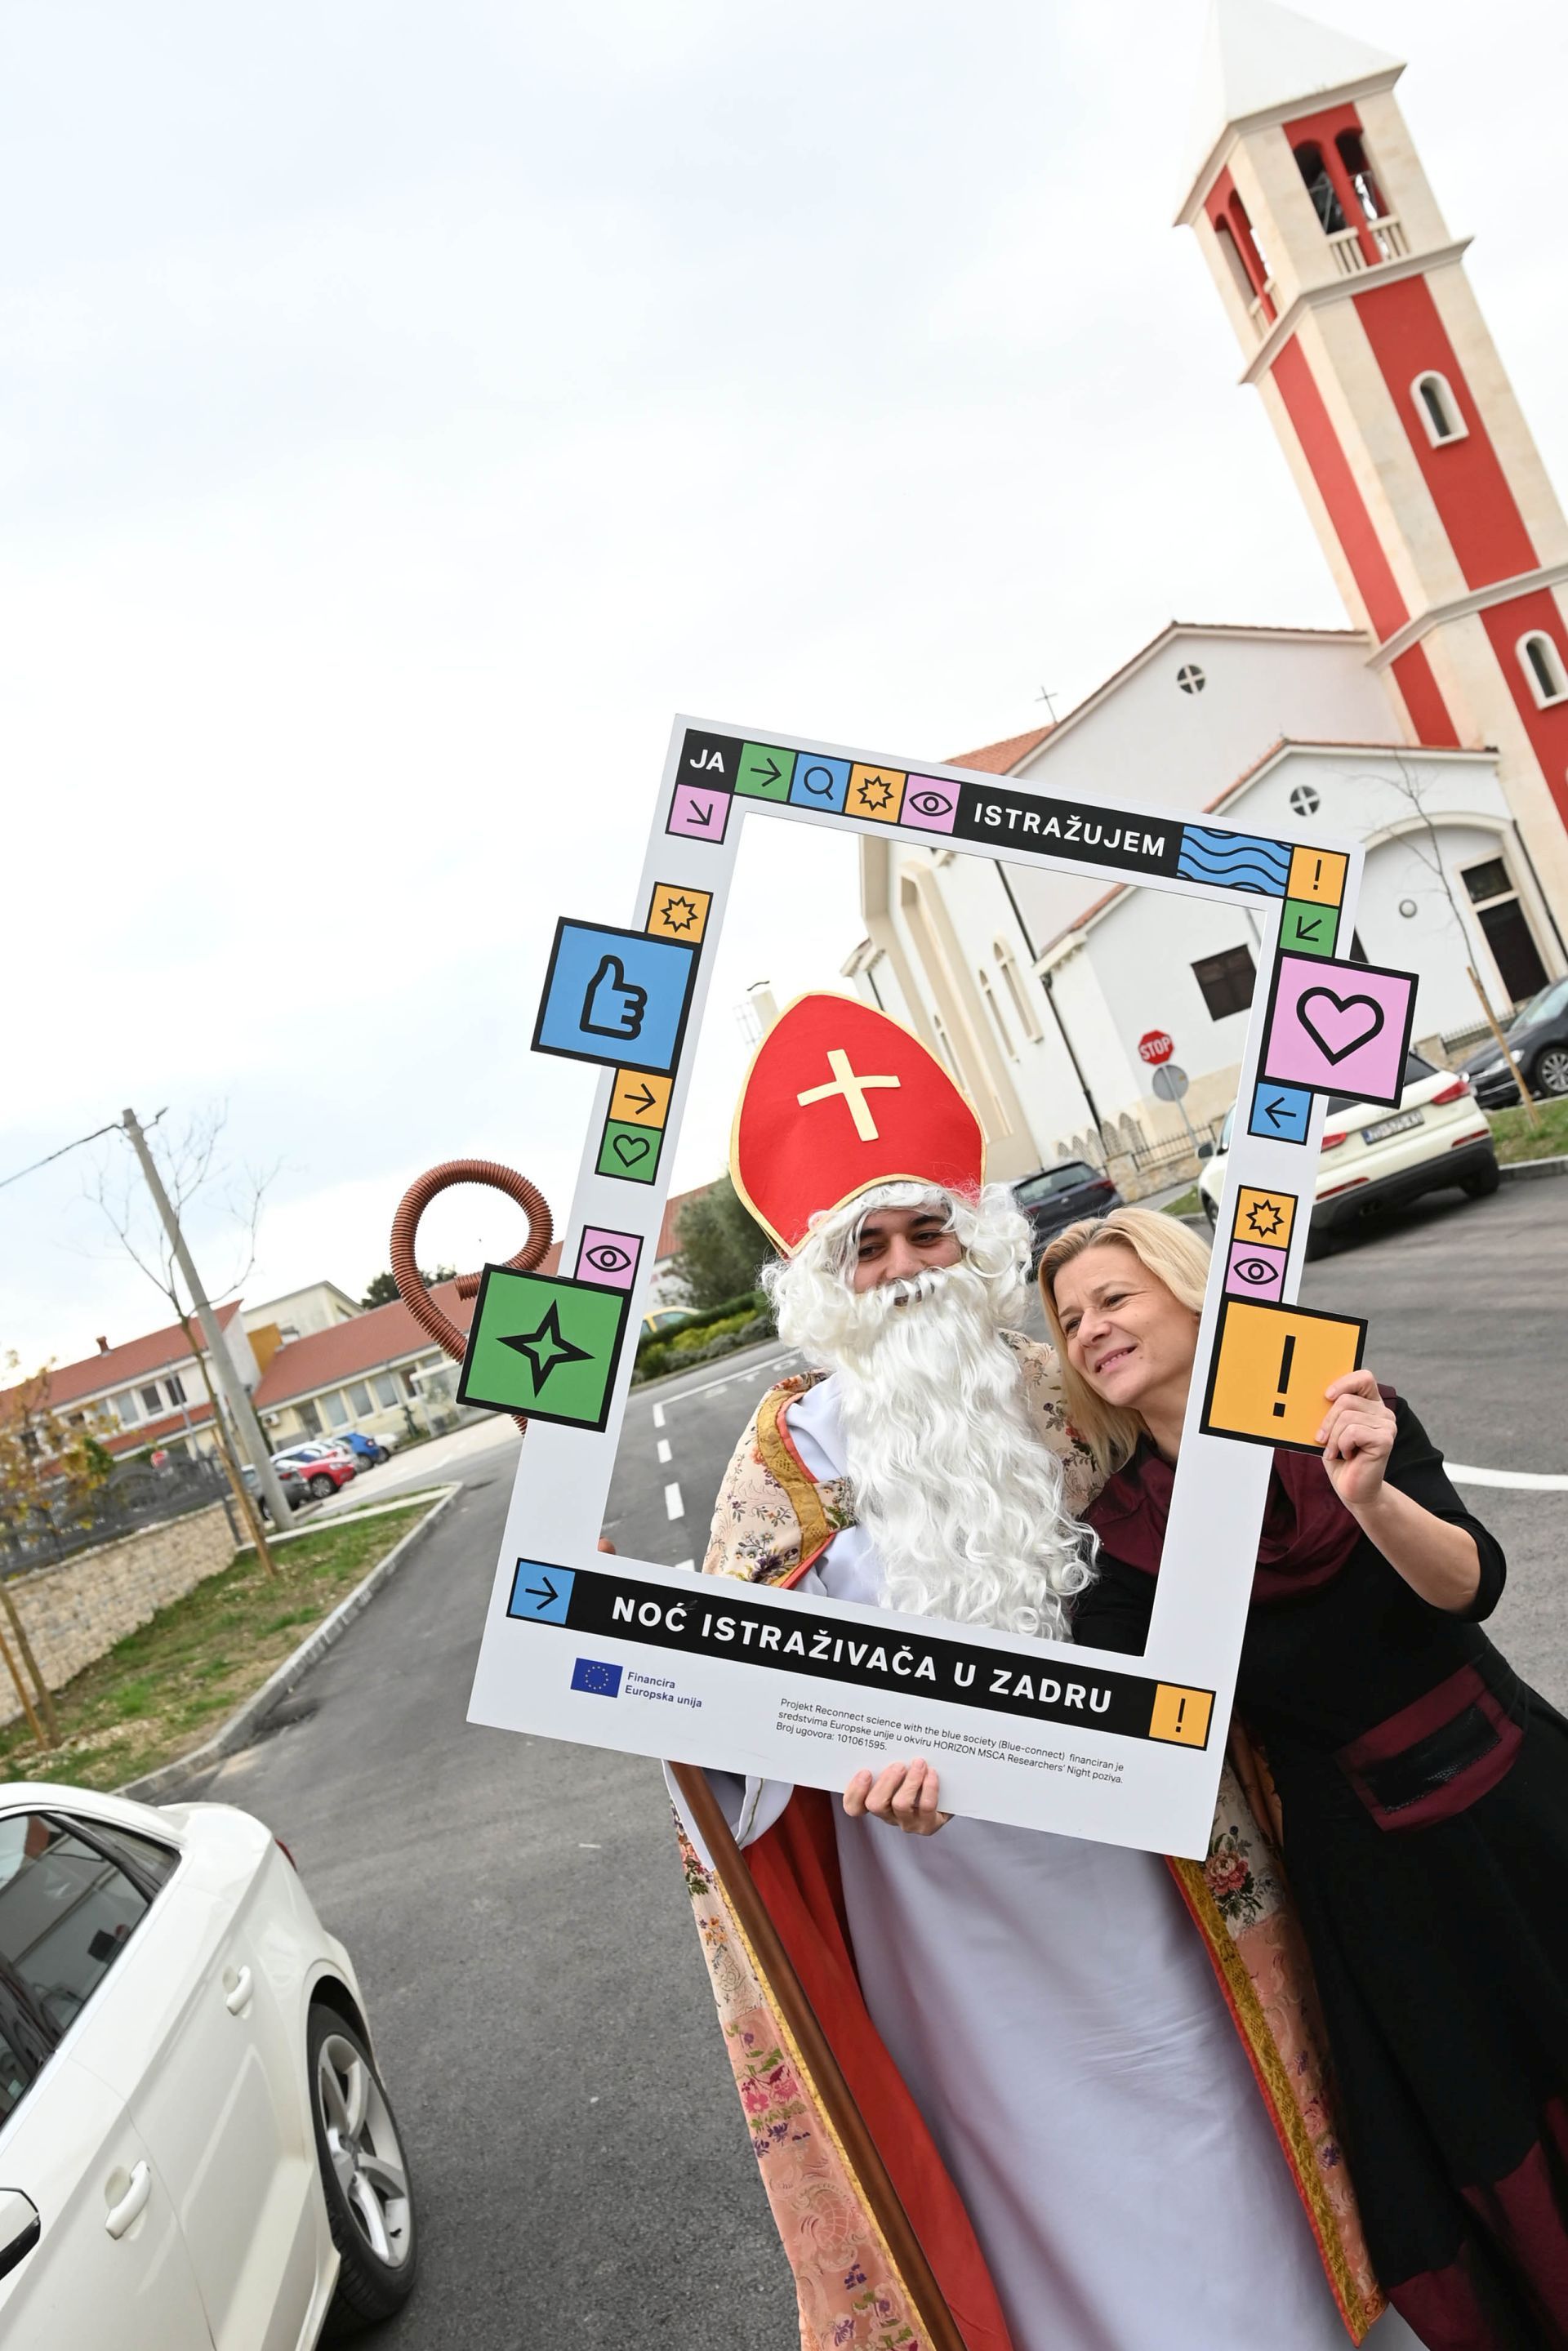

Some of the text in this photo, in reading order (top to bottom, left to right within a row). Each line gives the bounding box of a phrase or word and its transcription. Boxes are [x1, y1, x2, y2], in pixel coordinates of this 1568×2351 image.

[690, 750, 724, 773] JA
[975, 804, 1165, 857] ISTRAŽUJEM
[1140, 1035, 1171, 1060] STOP
[612, 1597, 1111, 1712] NOĆ ISTRAŽIVAČA U ZADRU
[628, 1672, 675, 1689] Financira
[626, 1685, 702, 1708] Europska unija
[777, 1722, 886, 1750] Broj ugovora: 101061595.
[778, 1712, 827, 1726] sredstvima
[830, 1720, 871, 1734] Europske
[874, 1730, 894, 1740] unije
[904, 1736, 931, 1746] okviru
[933, 1740, 976, 1755] HORIZON
[978, 1748, 1004, 1761] MSCA
[1067, 1765, 1090, 1777] Night
[1093, 1772, 1123, 1783] poziva.
[781, 1699, 813, 1712] Projekt
[815, 1705, 864, 1721] Reconnect
[866, 1717, 902, 1728] science
[904, 1724, 922, 1732] with
[925, 1727, 939, 1736] the
[942, 1730, 960, 1739] blue
[964, 1735, 996, 1748] society
[999, 1740, 1065, 1761] (Blue-connect)
[1070, 1754, 1113, 1769] financiran
